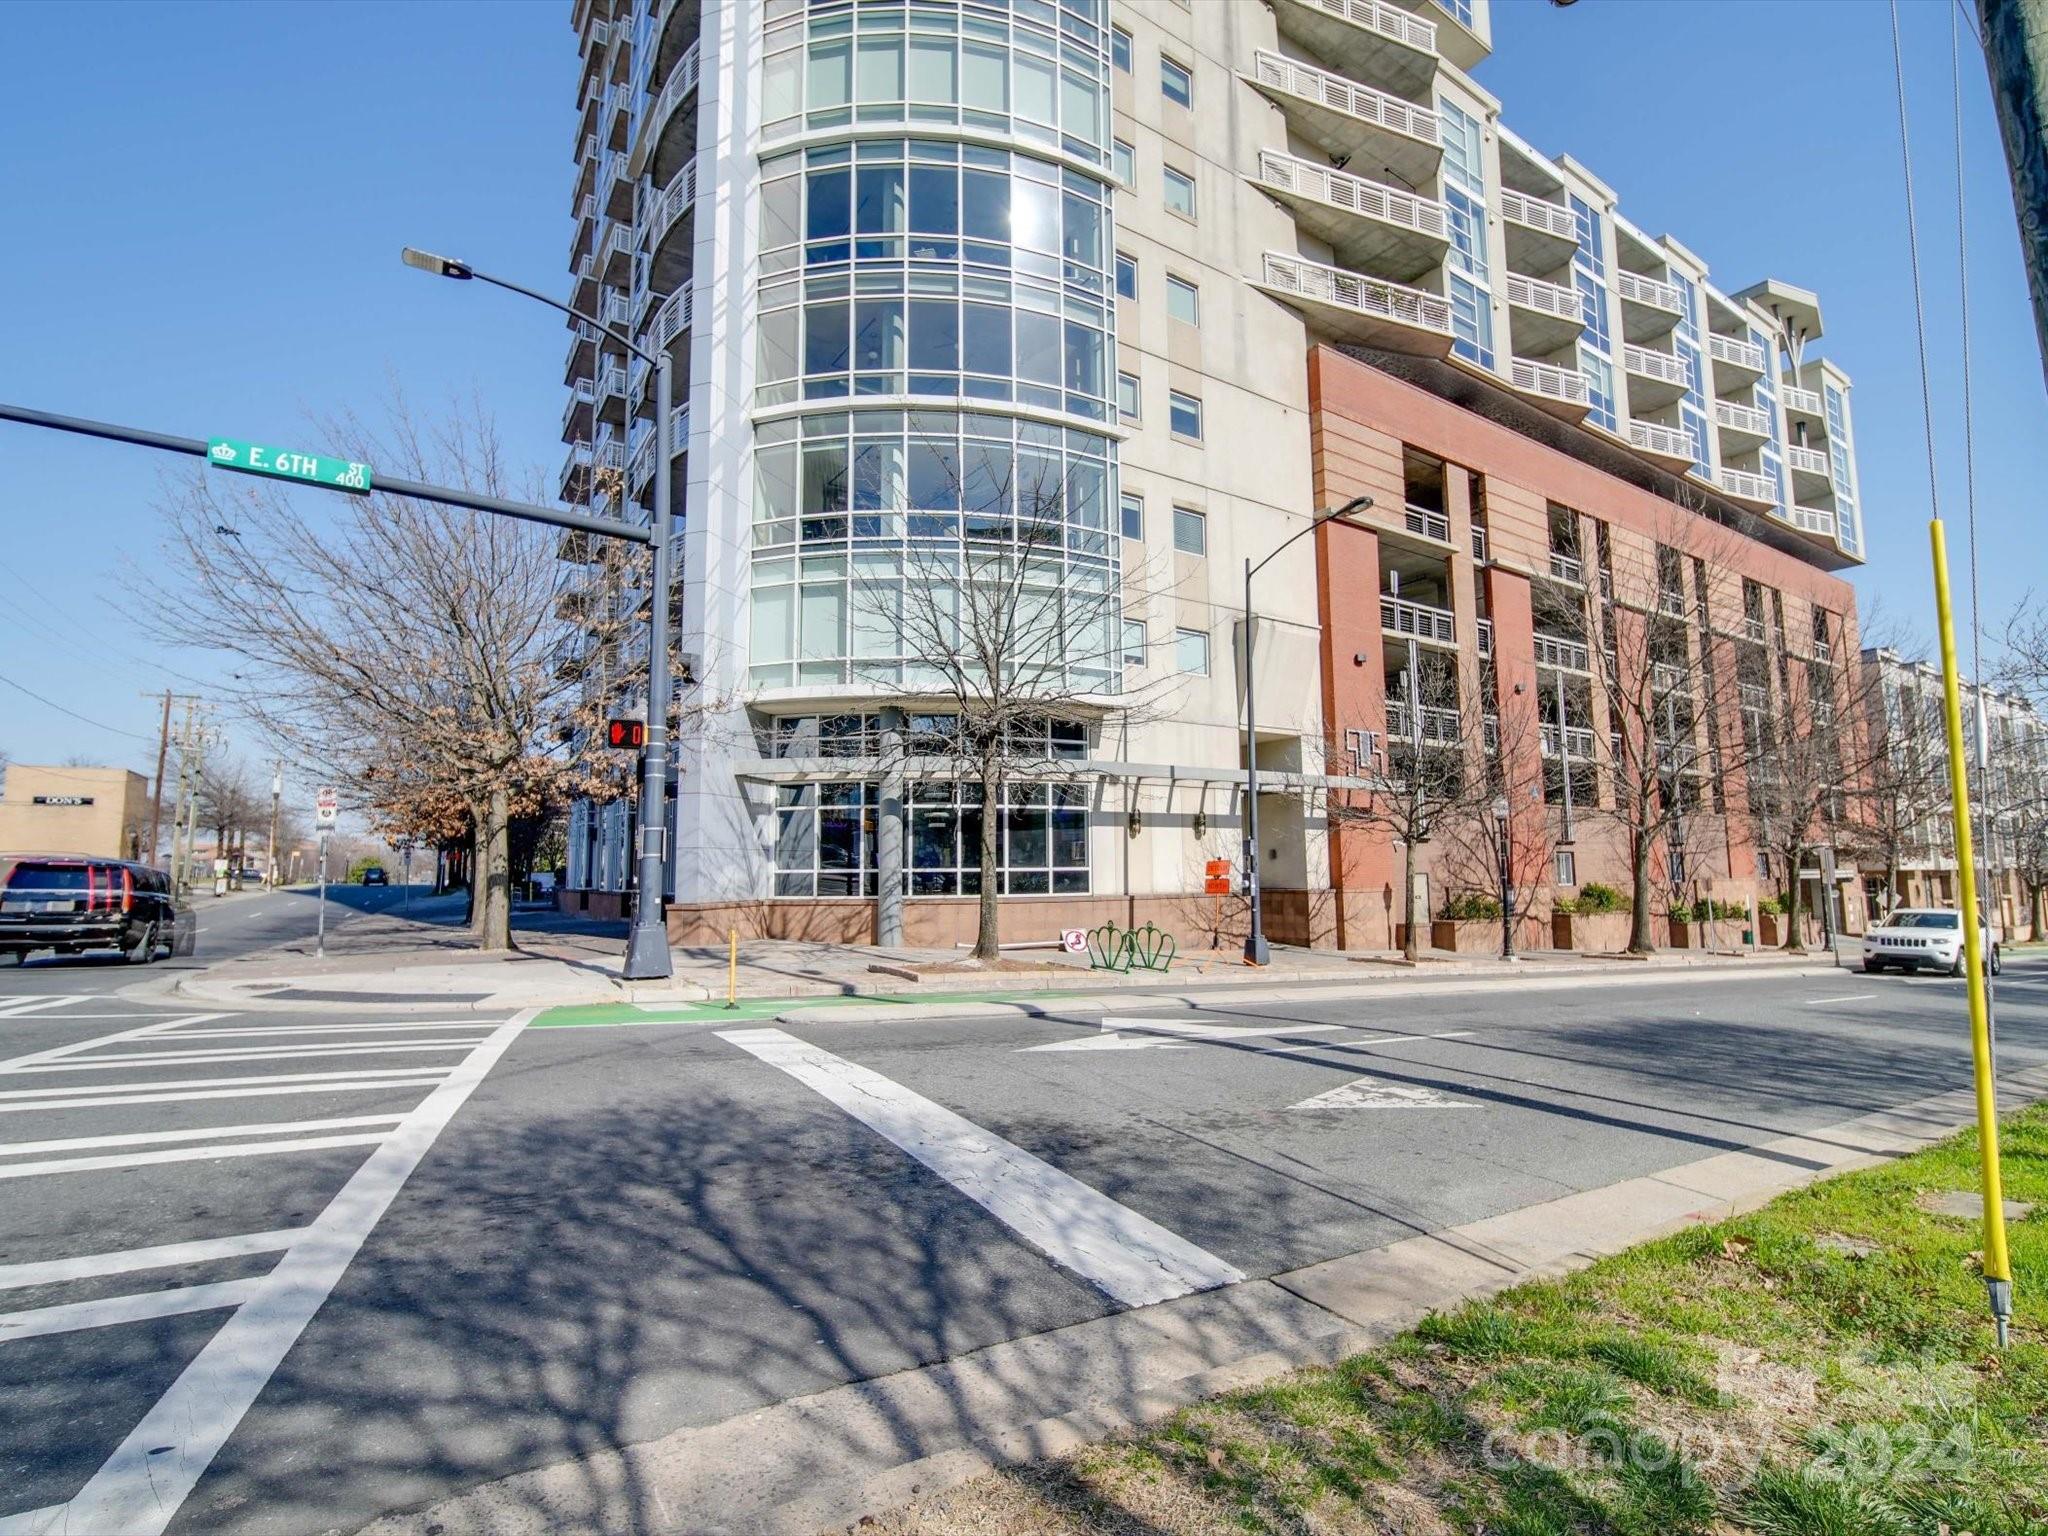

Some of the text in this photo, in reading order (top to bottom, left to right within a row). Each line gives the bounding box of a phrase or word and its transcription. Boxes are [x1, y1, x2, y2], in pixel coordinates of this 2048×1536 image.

[249, 447, 318, 476] E. 6TH
[348, 462, 365, 476] ST
[335, 472, 364, 488] 400
